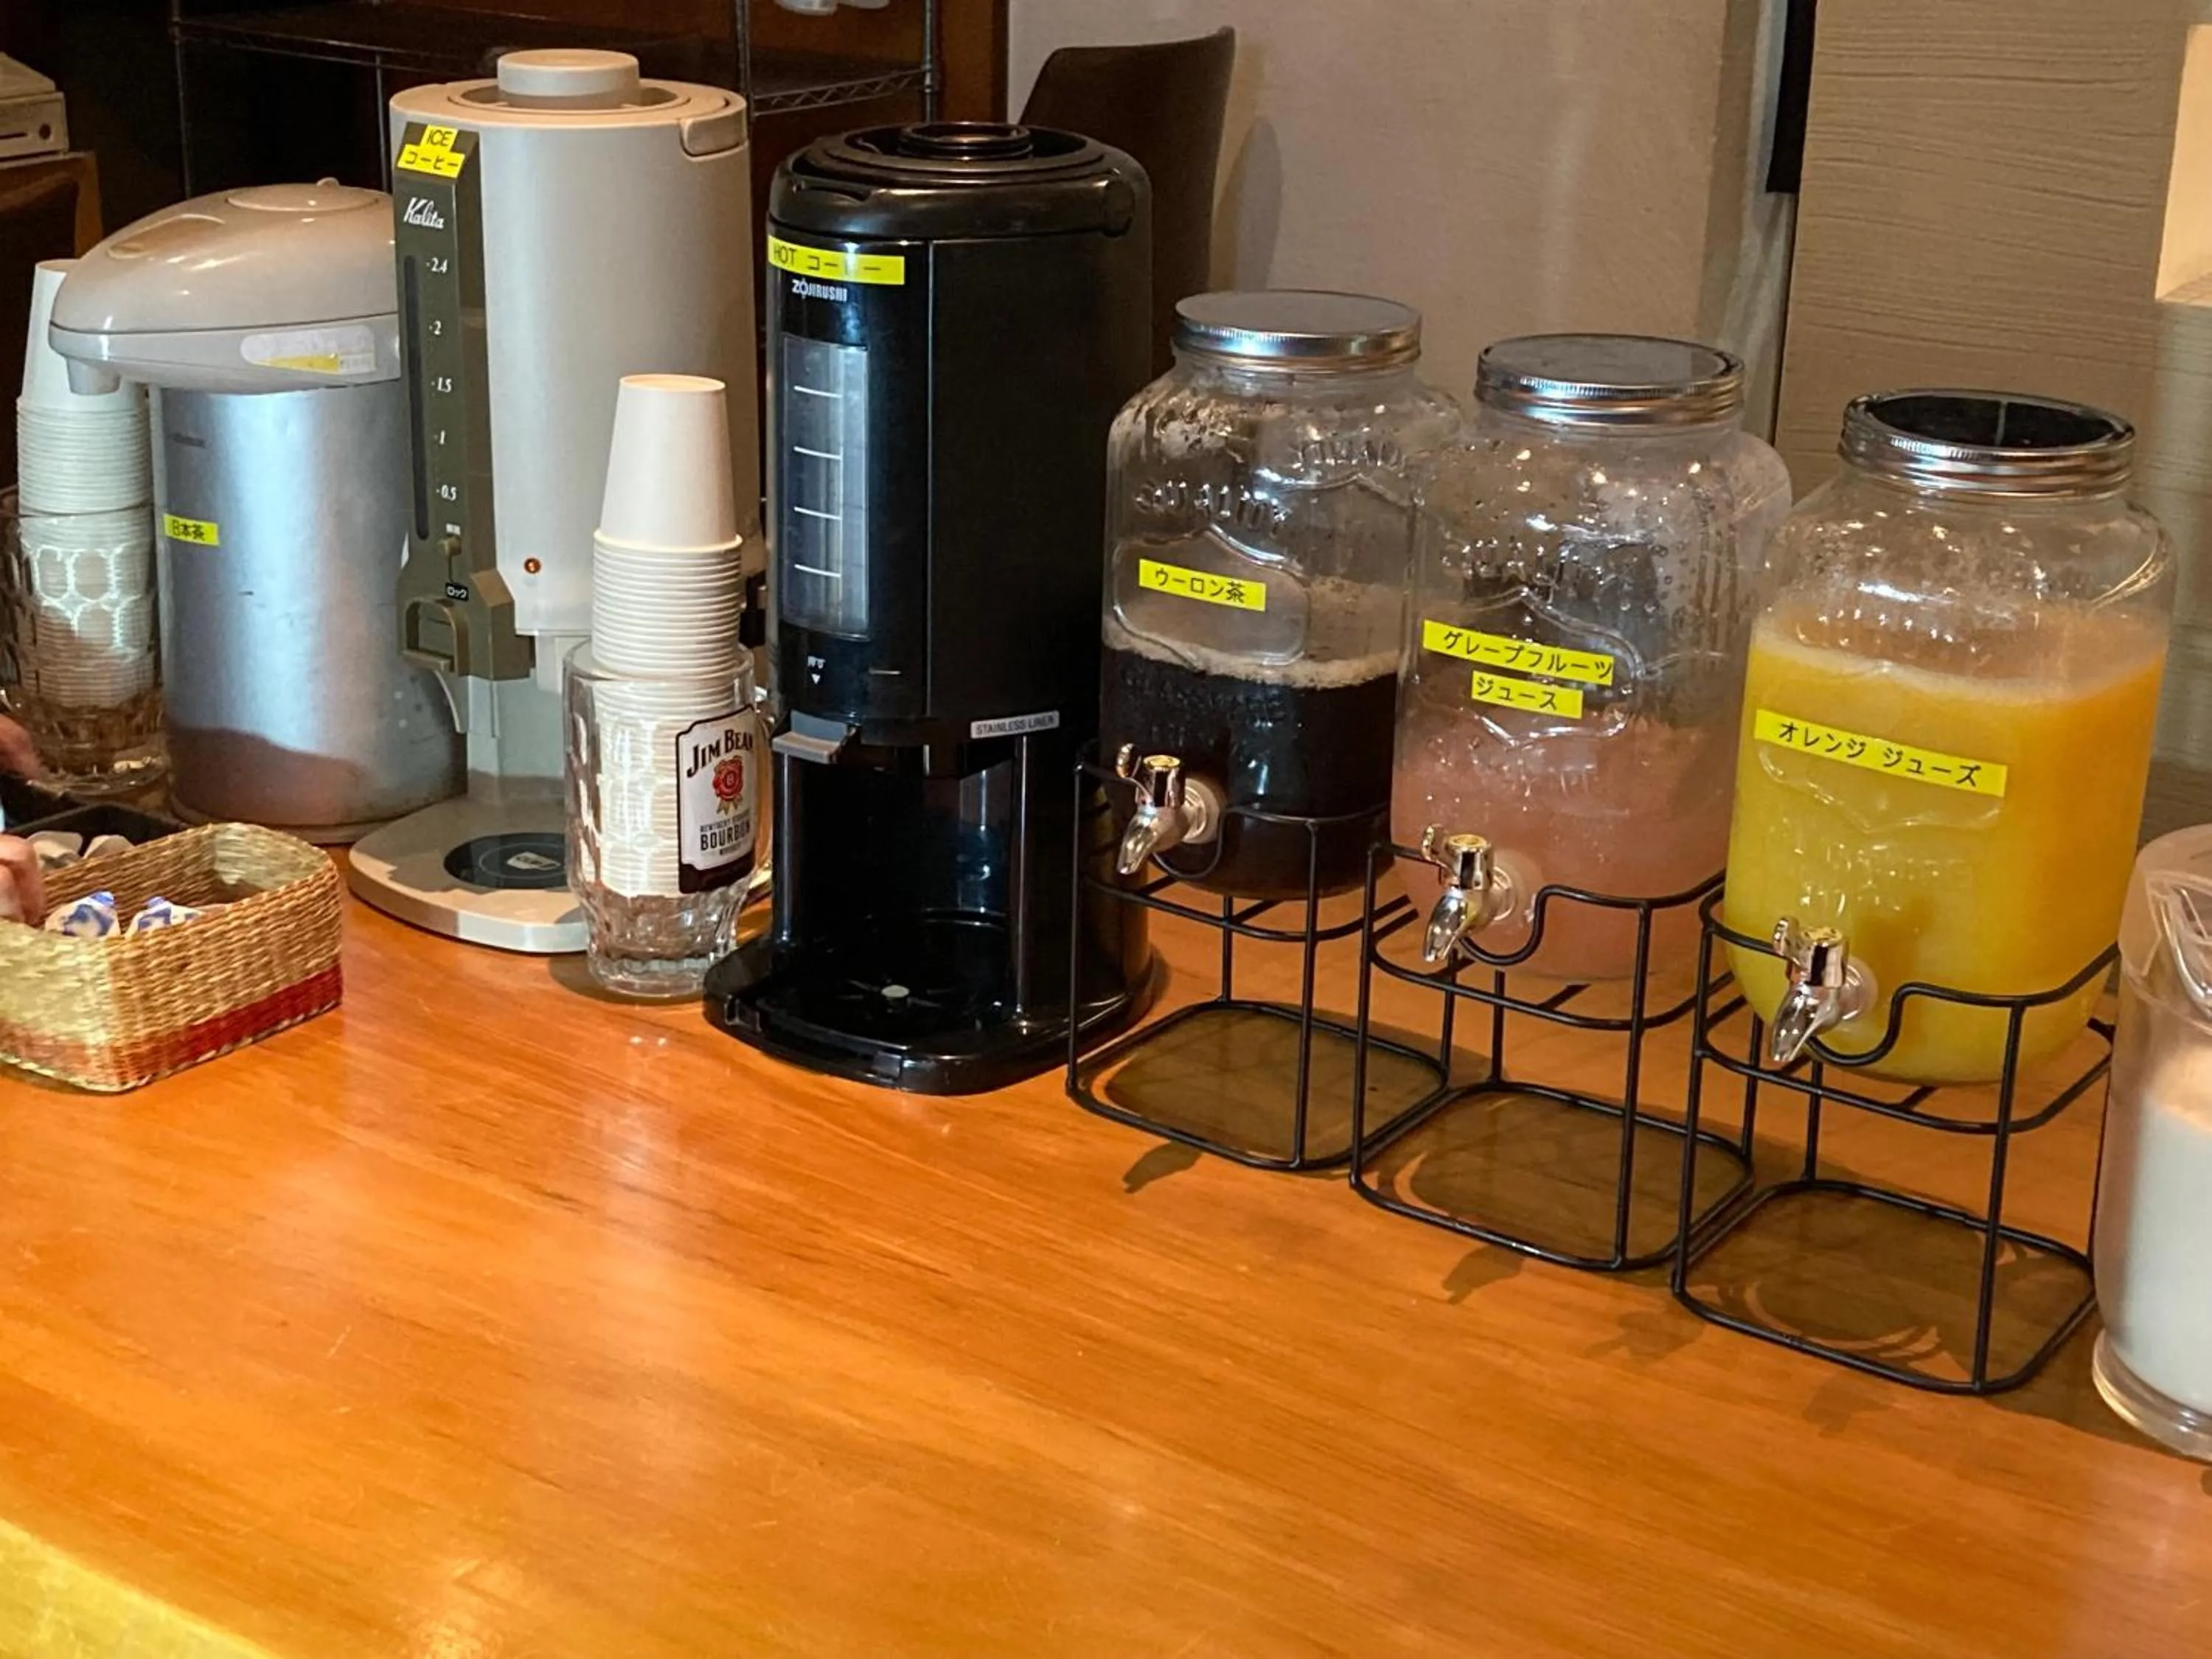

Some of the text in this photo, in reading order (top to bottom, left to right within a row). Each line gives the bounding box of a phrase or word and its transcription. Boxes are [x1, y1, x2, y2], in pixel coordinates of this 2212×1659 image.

[426, 130, 453, 146] ICE
[405, 151, 459, 170] コーヒー
[403, 197, 444, 229] Kalita
[773, 245, 881, 272] HOT コーー
[791, 277, 848, 302] ZOJIRUSHI
[434, 320, 442, 335] 2
[439, 430, 445, 445] 1
[172, 519, 206, 541] 日本茶
[1155, 567, 1246, 604] ウーロン茶
[1443, 630, 1613, 678] グレープフルーツ
[1476, 676, 1558, 711] ジュース
[1778, 722, 1865, 759] オレンジ
[687, 740, 721, 778] JIM
